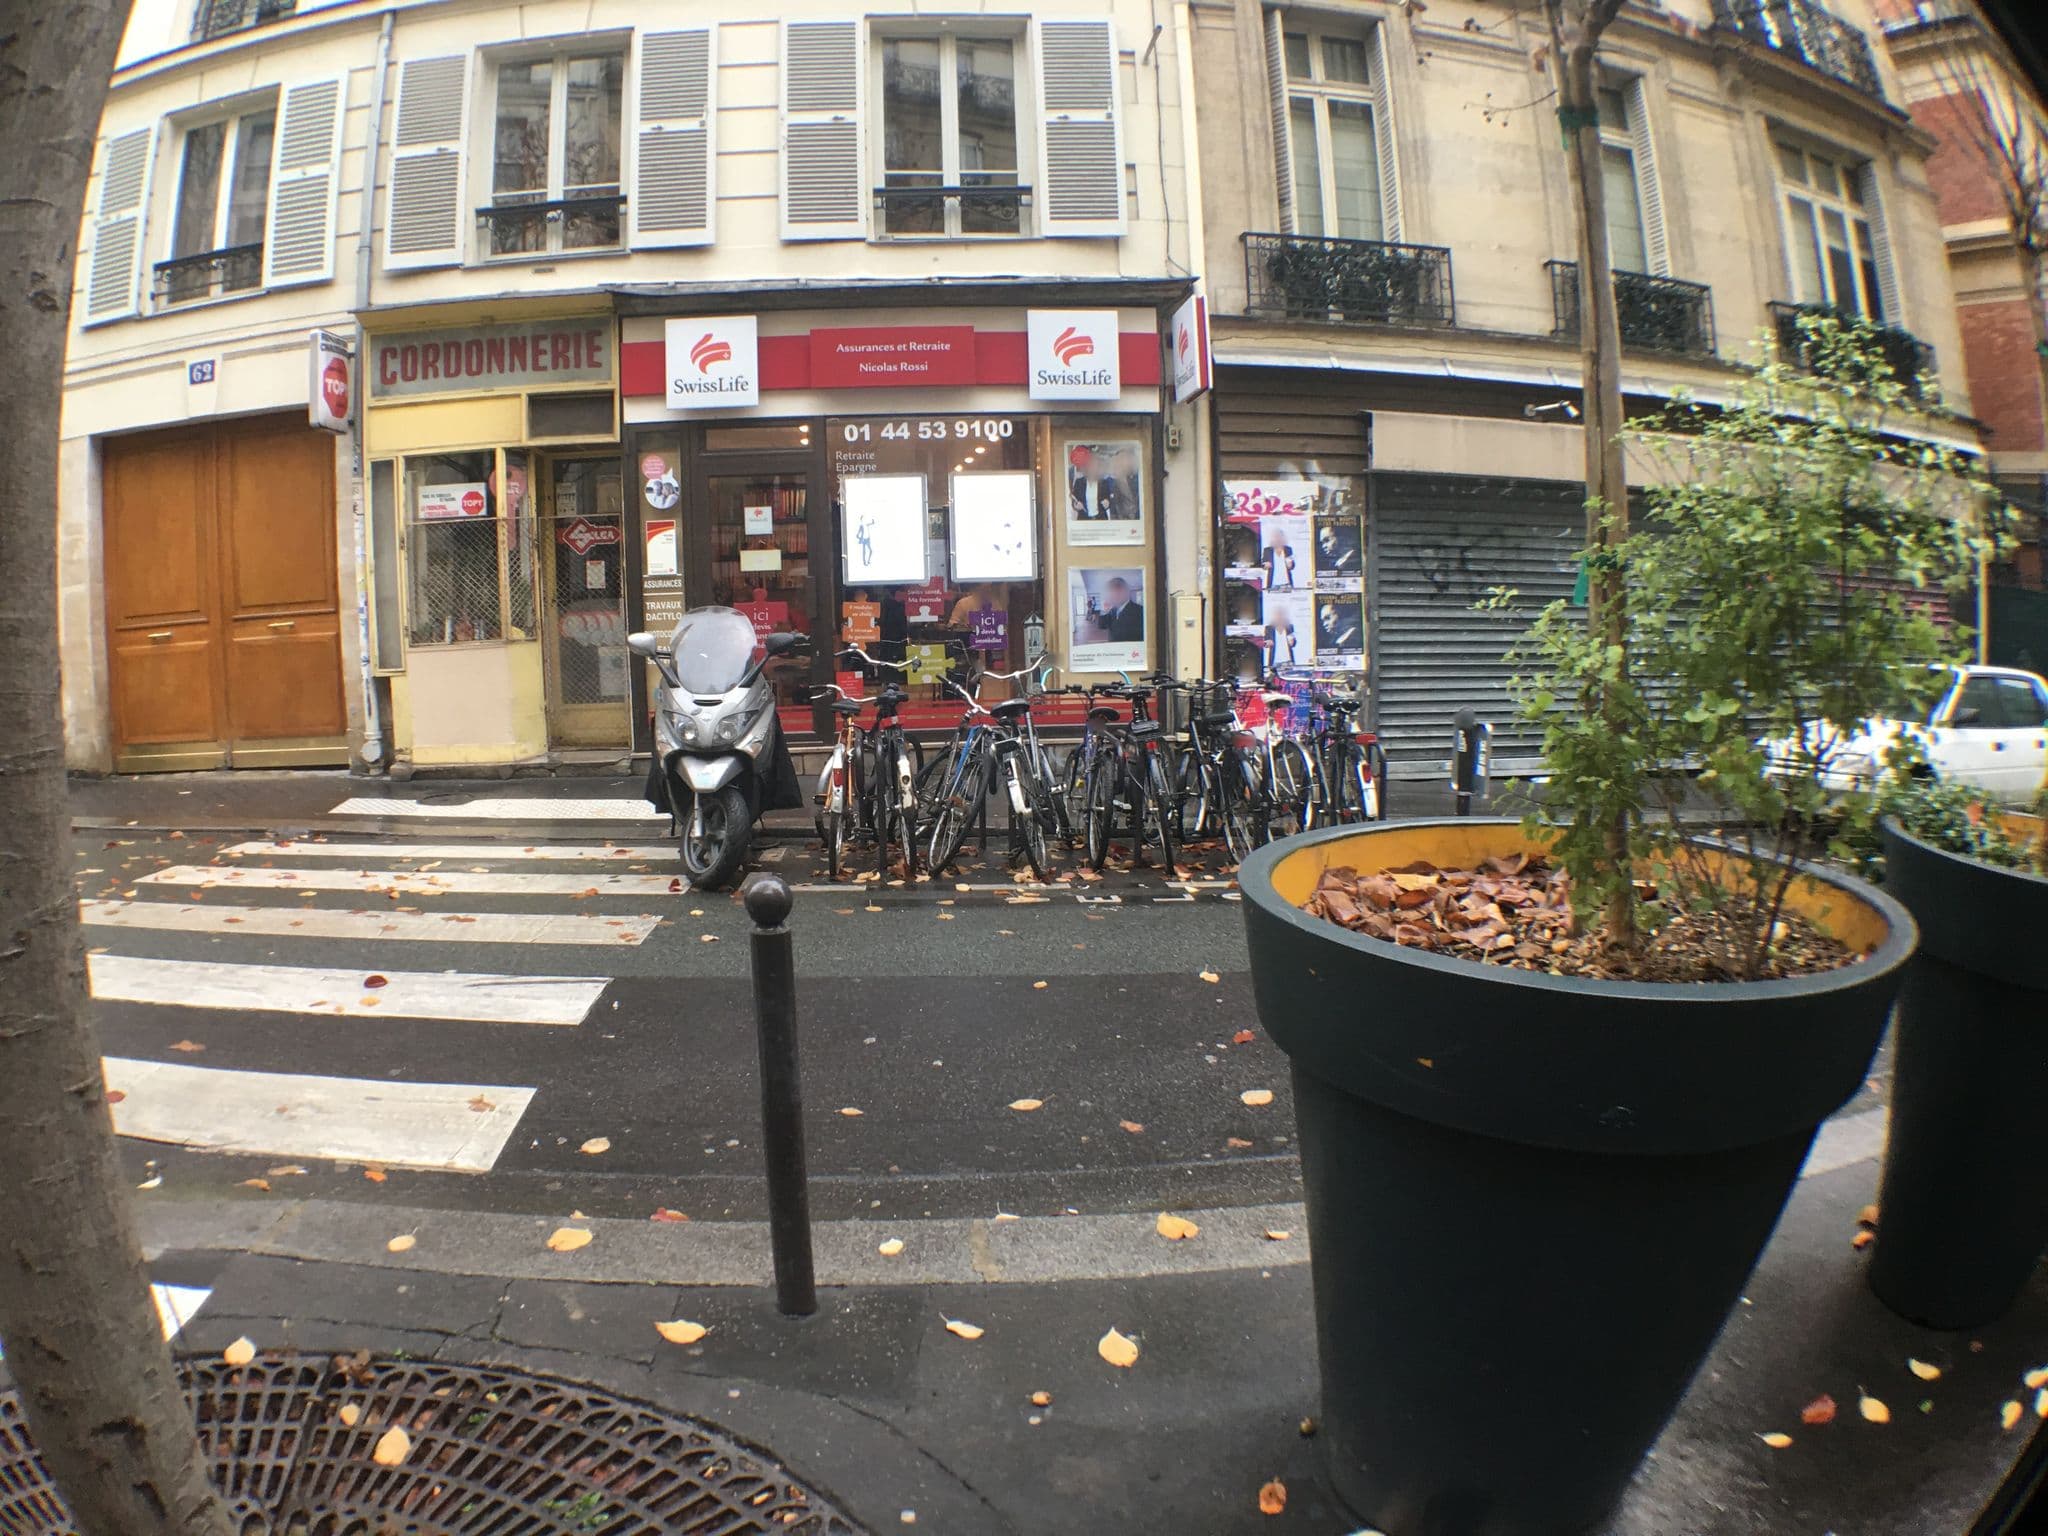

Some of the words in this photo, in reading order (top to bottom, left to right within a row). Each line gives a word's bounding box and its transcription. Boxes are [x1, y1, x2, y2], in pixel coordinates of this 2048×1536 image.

[836, 343, 895, 353] Assurances
[897, 344, 907, 352] et
[909, 341, 951, 352] Retraite
[379, 329, 603, 386] CORDONNERIE
[193, 363, 212, 382] 62
[859, 361, 898, 372] Nicolas
[900, 361, 928, 371] Rossi
[1037, 369, 1112, 386] SwissLife
[673, 375, 749, 395] SwissLife
[844, 424, 871, 442] 01
[880, 422, 910, 440] 44
[918, 421, 947, 439] 53
[954, 420, 1013, 439] 9100
[835, 450, 875, 461] Retraite
[836, 462, 877, 475] Epargne
[644, 580, 682, 589] ASSURANCES
[645, 601, 682, 610] TRAVAUX
[645, 612, 682, 621] DACTYLO
[753, 607, 769, 621] ici
[981, 613, 995, 626] ici
